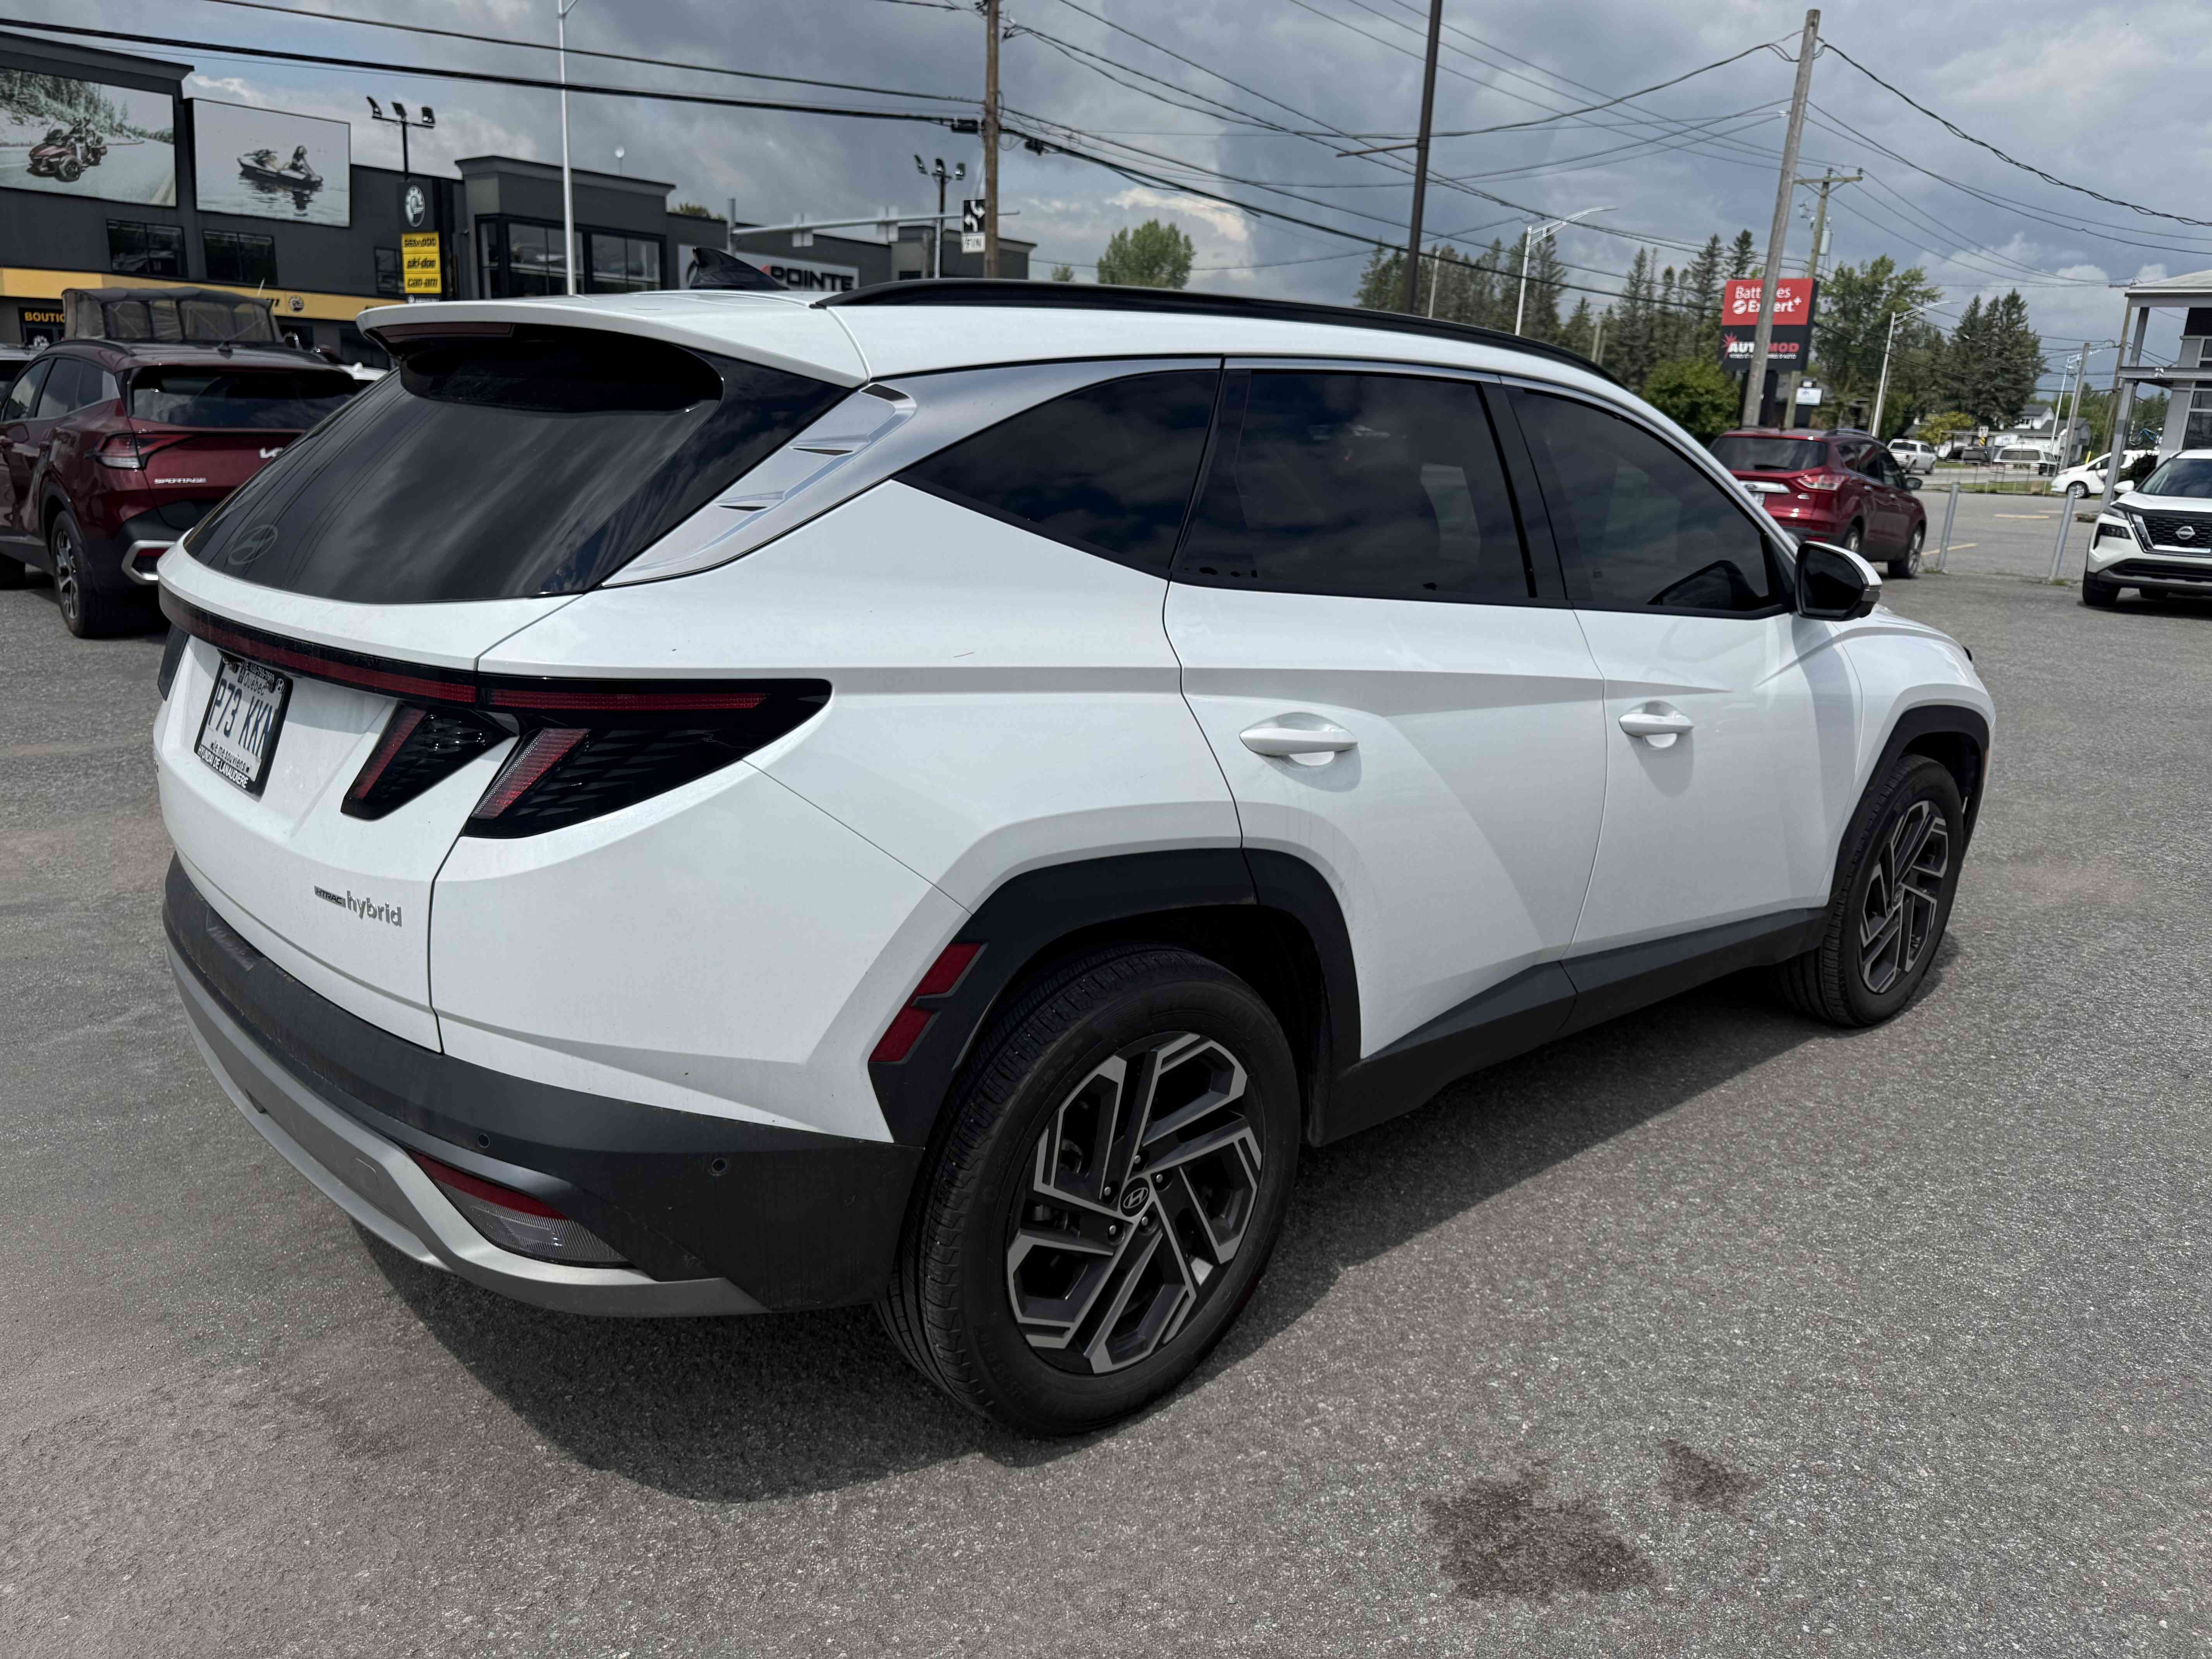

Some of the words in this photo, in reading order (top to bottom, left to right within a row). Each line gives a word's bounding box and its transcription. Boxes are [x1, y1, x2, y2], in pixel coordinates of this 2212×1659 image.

[771, 266, 854, 291] POINTE
[1735, 285, 1791, 299] Battes
[1727, 341, 1800, 353] AUTMOD
[243, 672, 266, 696] Québec
[208, 678, 242, 738] P73
[198, 745, 215, 765] HYUNDAI
[213, 756, 221, 770] DE
[218, 746, 225, 757] me
[224, 750, 246, 771] souviens
[316, 887, 342, 905] HTRAC
[347, 890, 402, 927] hybrid
